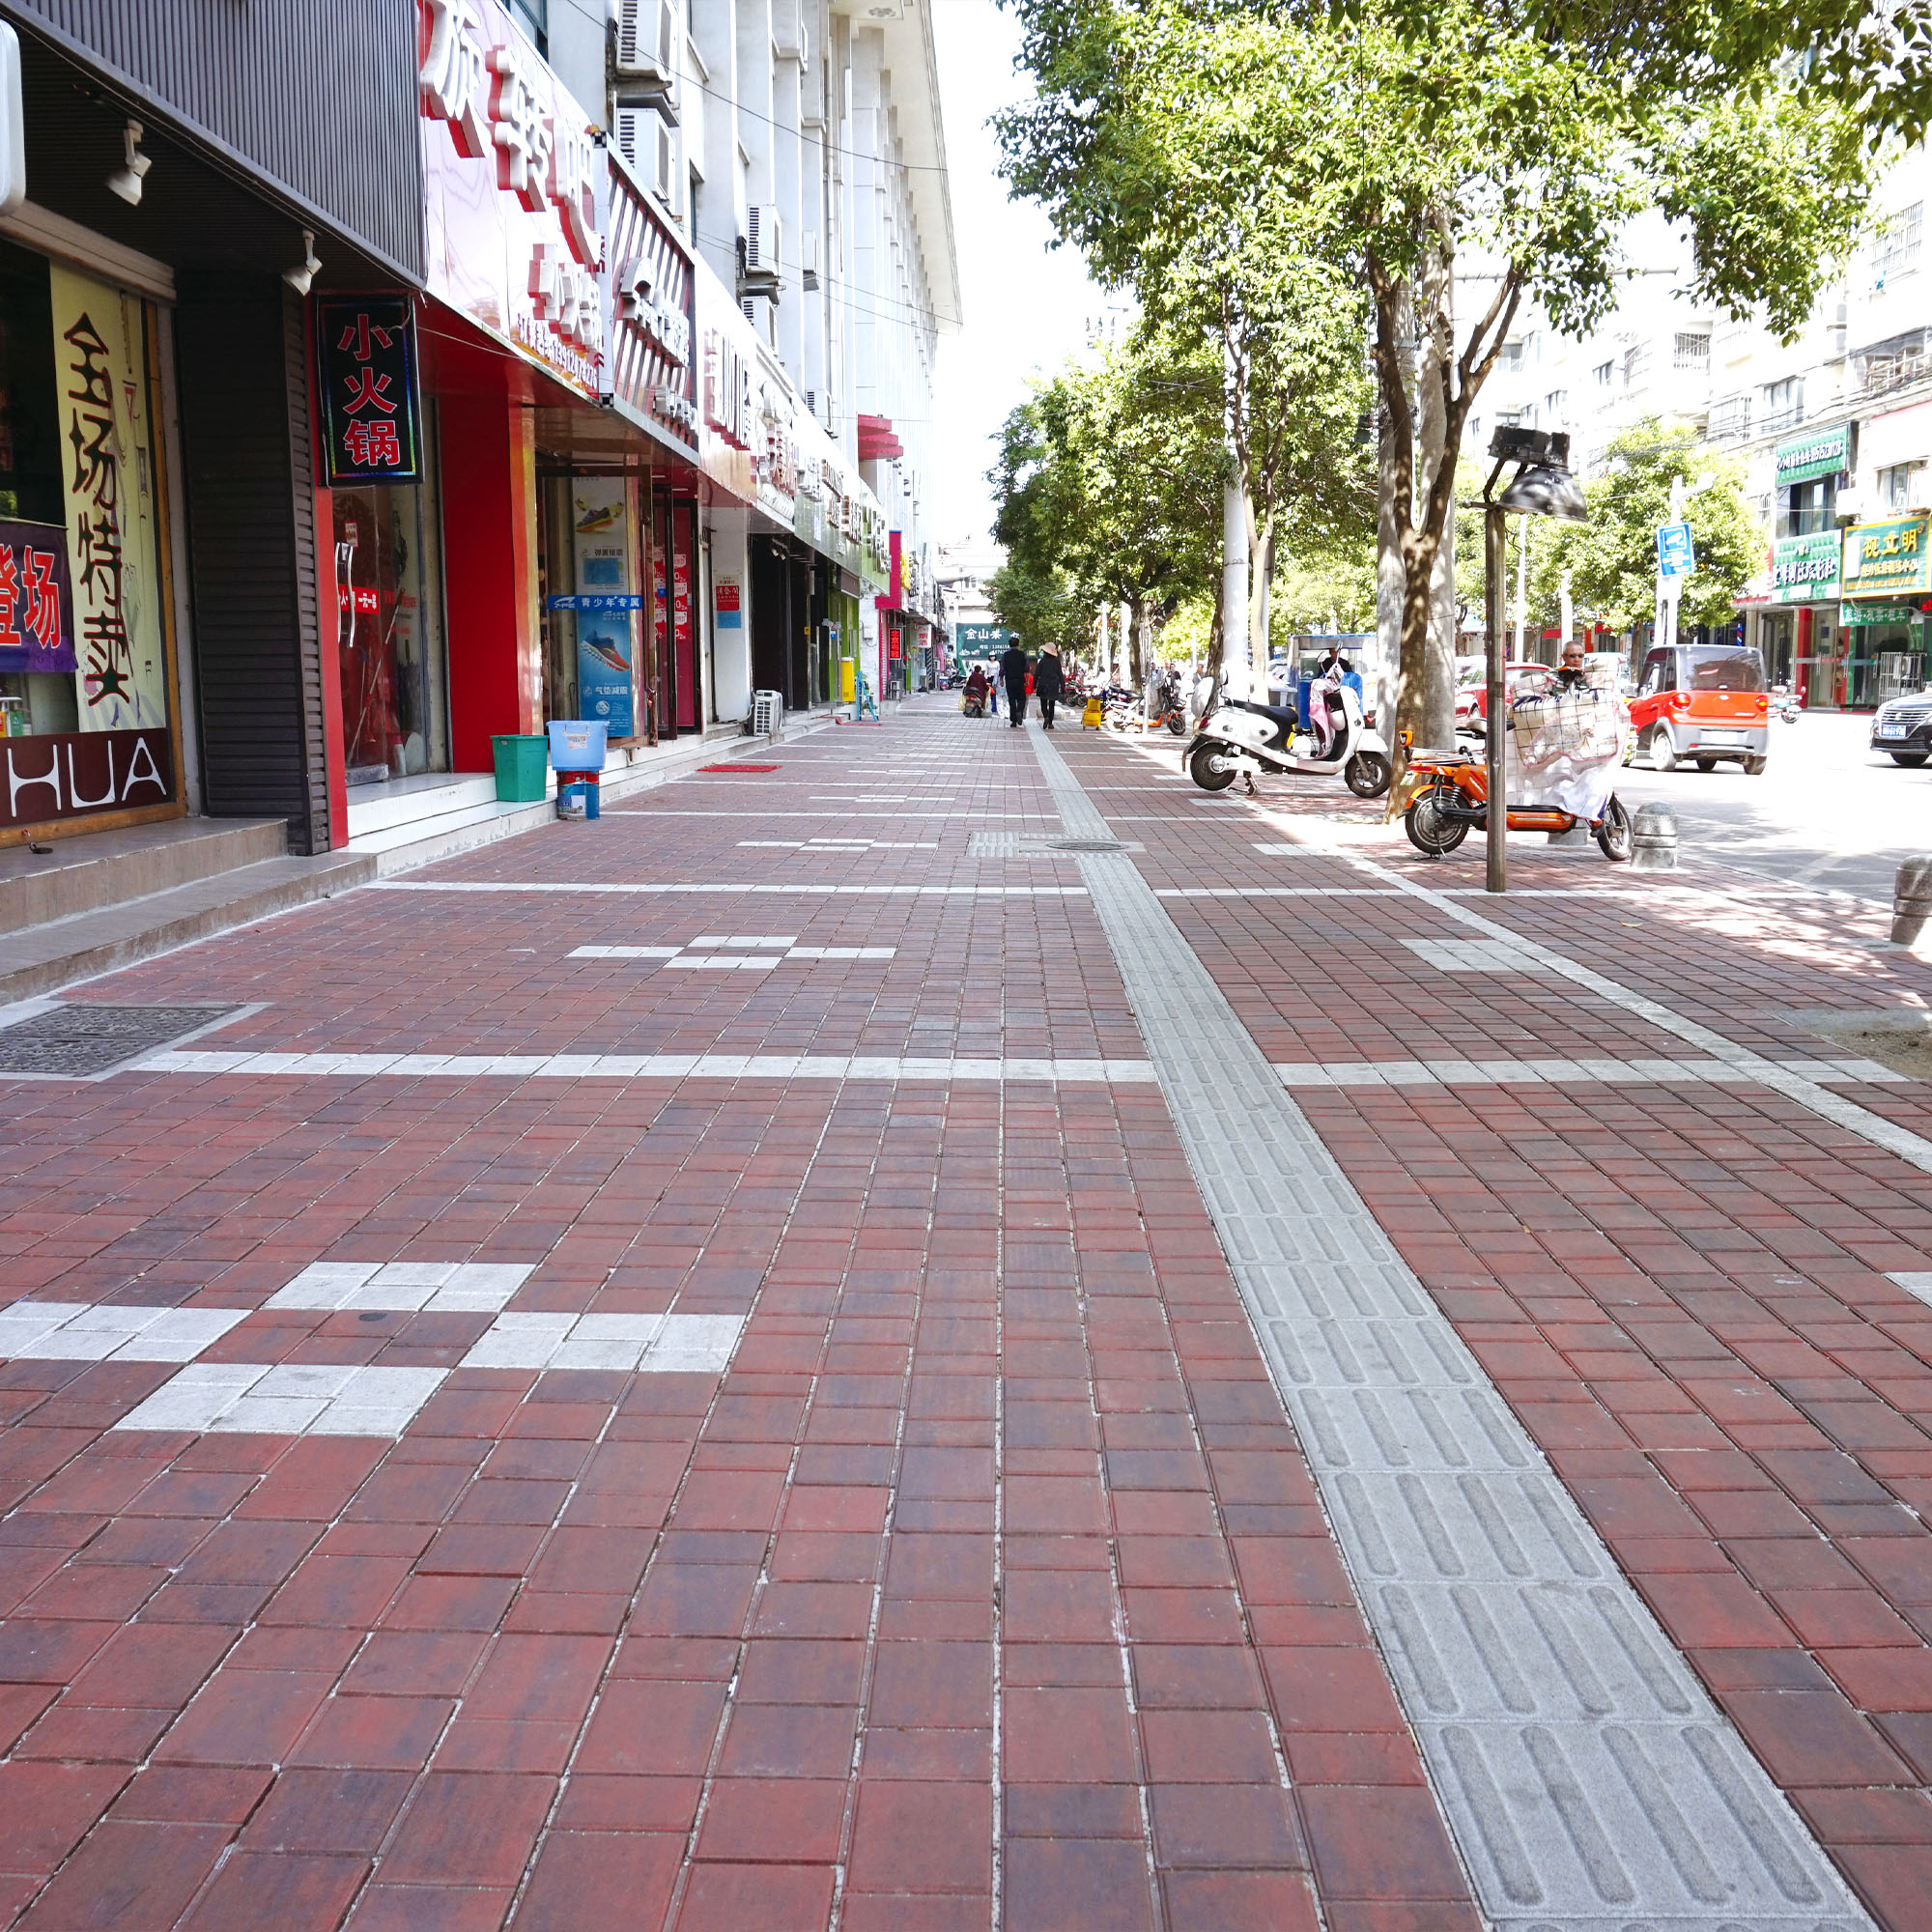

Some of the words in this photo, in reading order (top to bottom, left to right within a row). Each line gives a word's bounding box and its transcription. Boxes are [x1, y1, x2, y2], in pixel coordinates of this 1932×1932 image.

[337, 313, 401, 466] 小火锅
[64, 312, 129, 705] 全场特卖
[1861, 529, 1918, 558] 视立明
[7, 736, 167, 818] HUA
